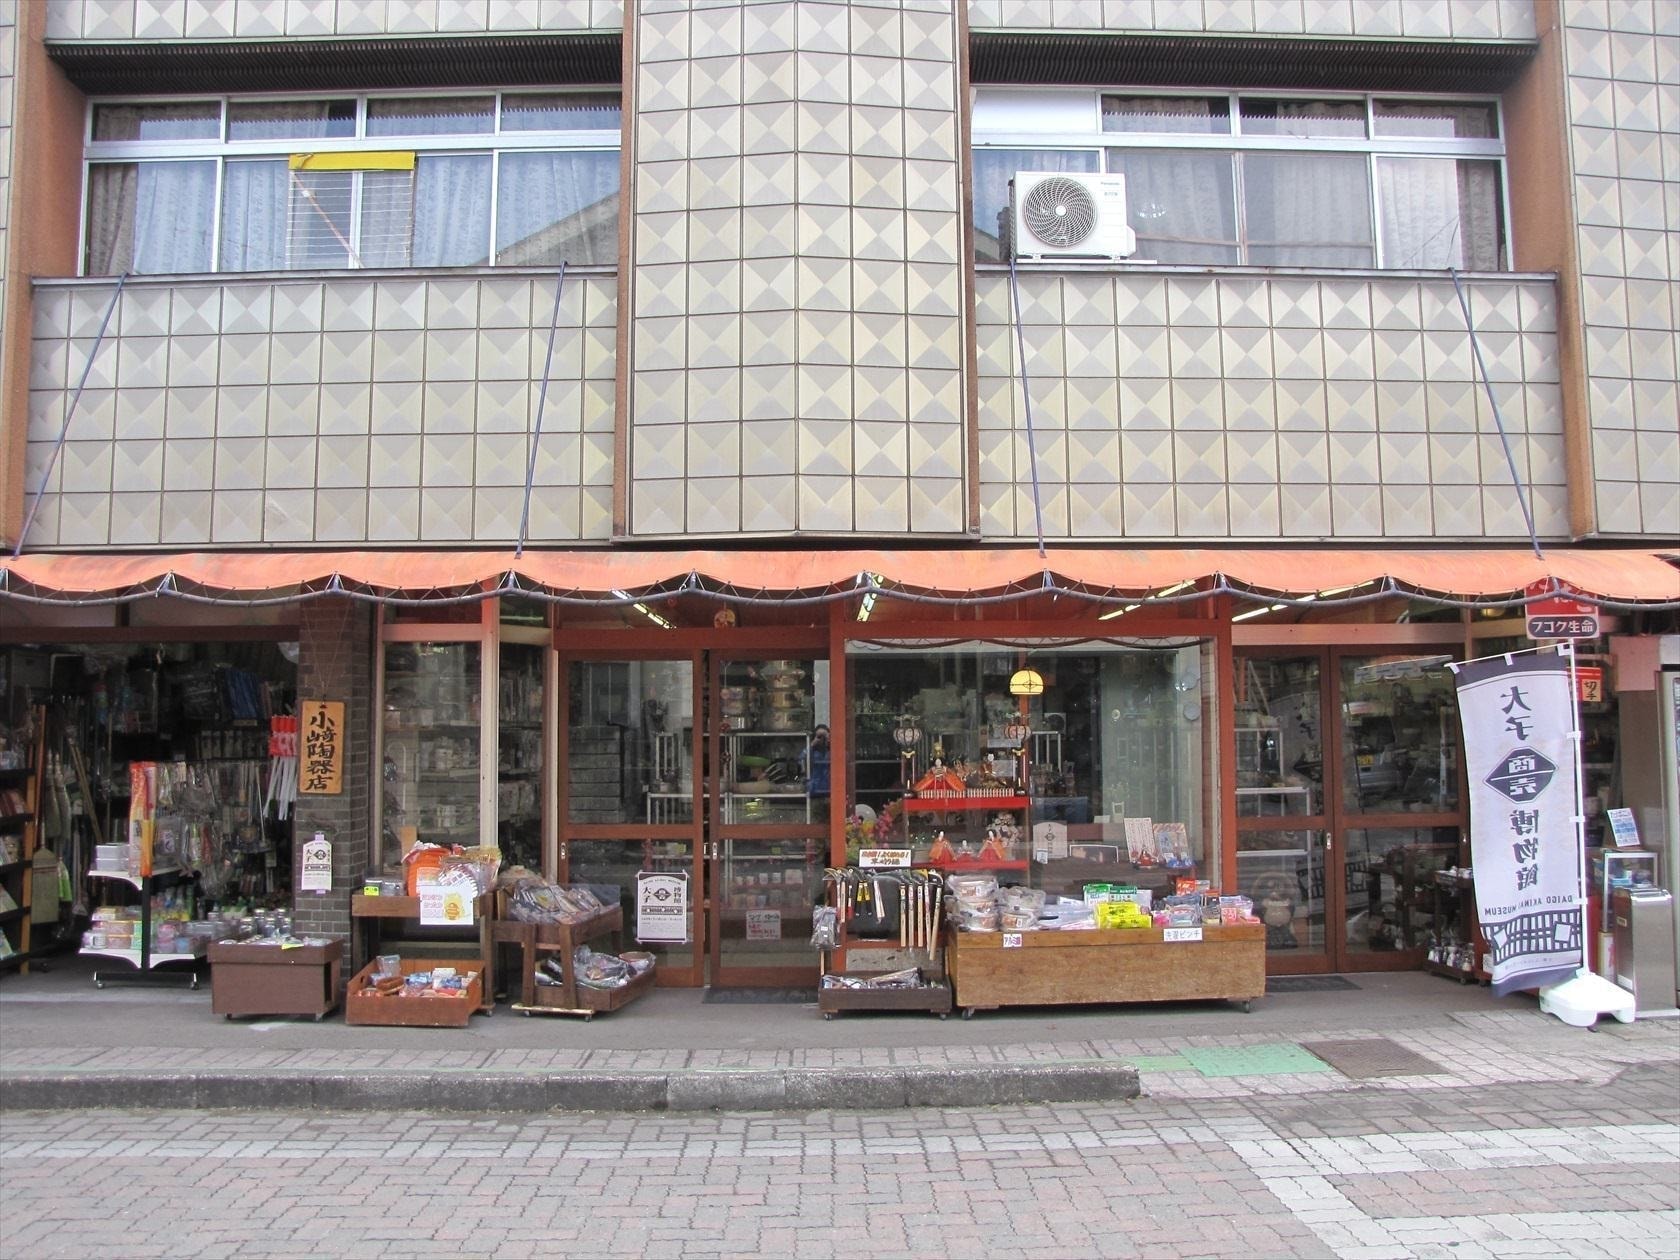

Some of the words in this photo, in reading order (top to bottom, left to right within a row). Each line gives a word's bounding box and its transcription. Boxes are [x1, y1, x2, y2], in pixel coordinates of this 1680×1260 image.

[1531, 620, 1594, 633] フコク生命
[1583, 680, 1598, 700] 切手
